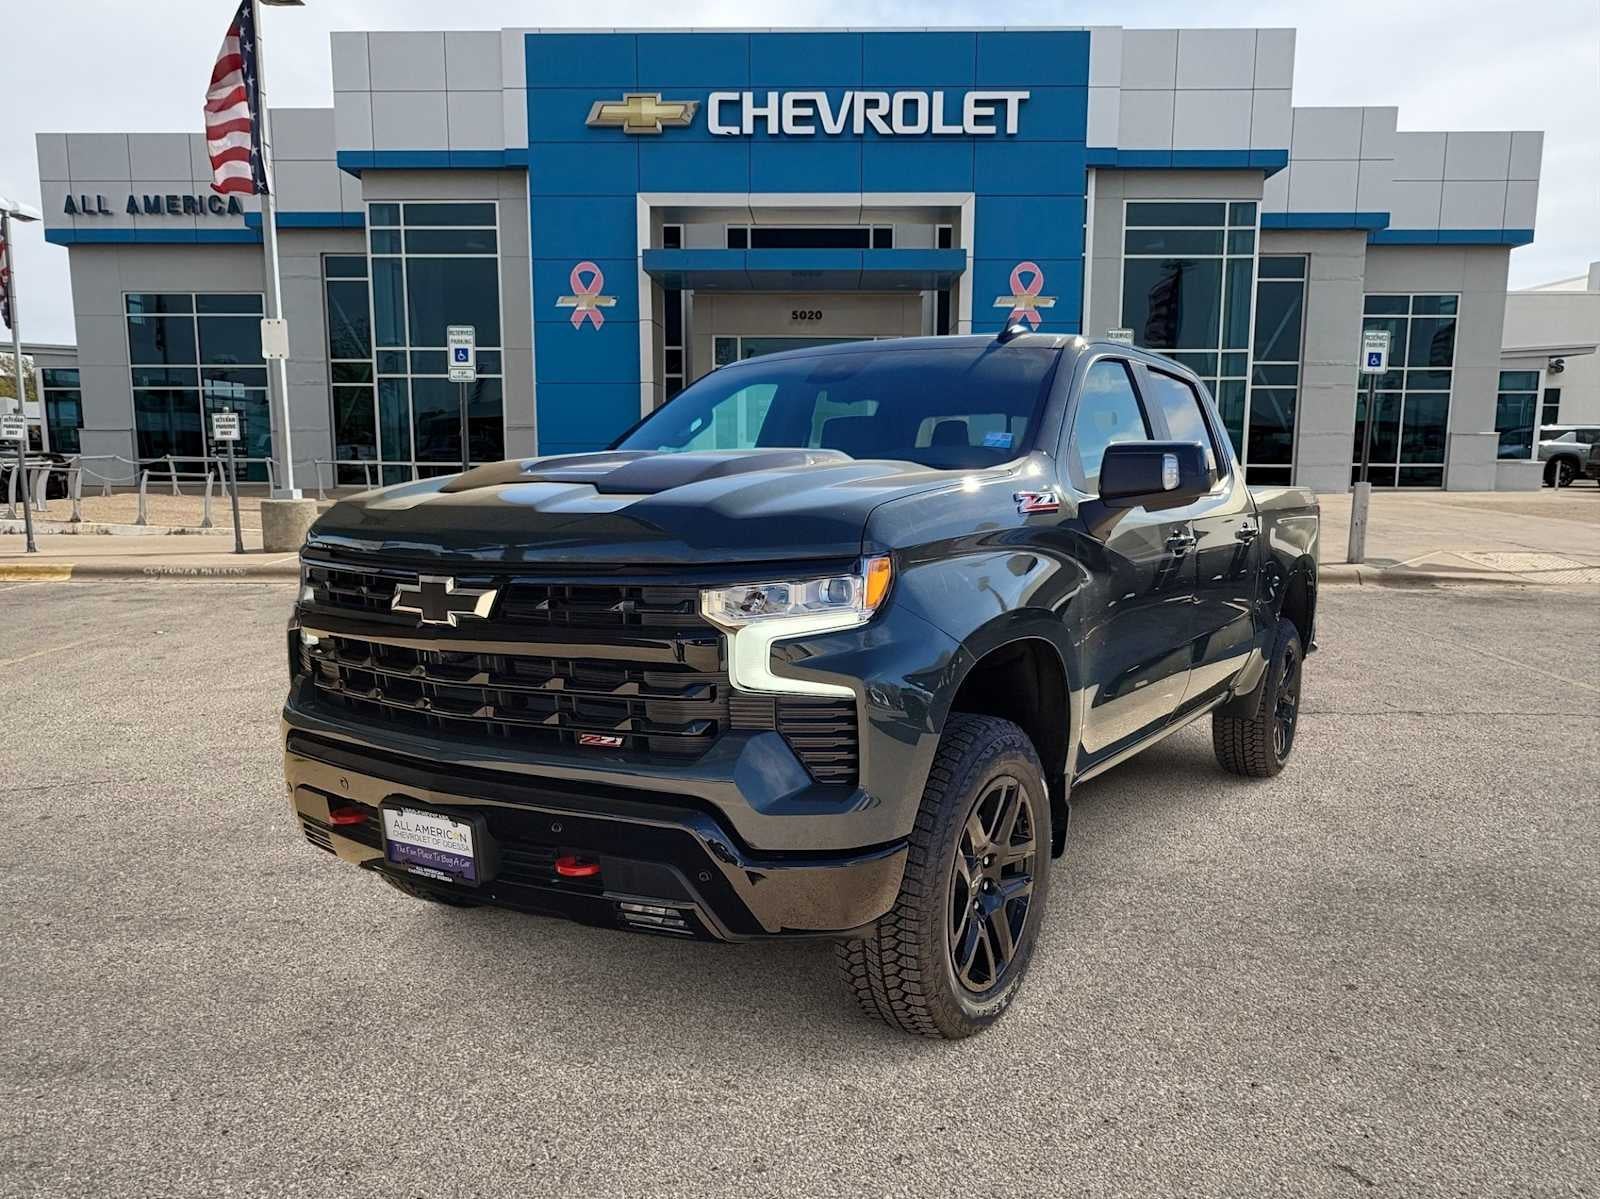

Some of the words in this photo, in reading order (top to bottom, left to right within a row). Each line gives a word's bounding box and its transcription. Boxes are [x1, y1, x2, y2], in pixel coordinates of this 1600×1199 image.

[708, 91, 1030, 135] CHEVROLET
[64, 194, 112, 215] ALL
[126, 194, 242, 215] AMERICA
[792, 310, 823, 320] 5020
[579, 733, 623, 747] Z71
[393, 819, 411, 832] ALL
[392, 829, 431, 844] CHEVROLET
[432, 837, 441, 846] OF
[394, 844, 406, 854] The
[433, 851, 441, 861] To
[460, 858, 471, 869] Car
